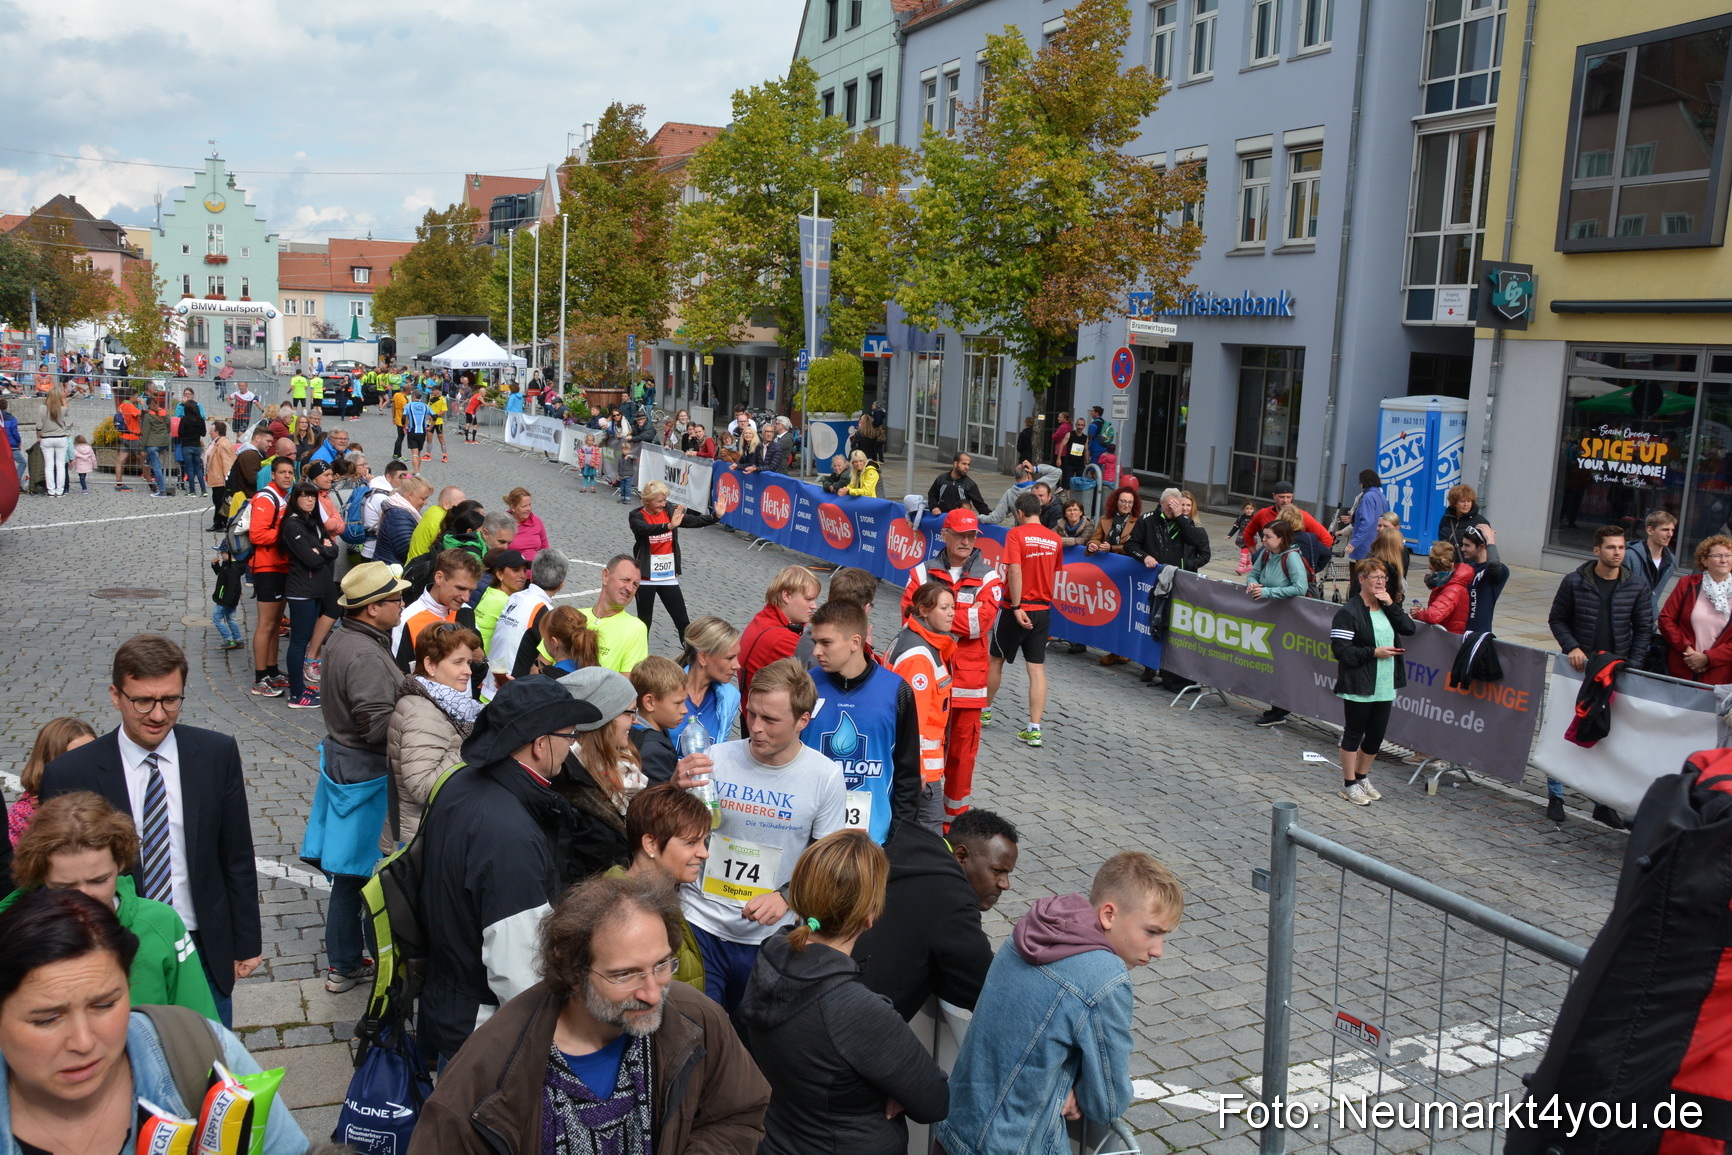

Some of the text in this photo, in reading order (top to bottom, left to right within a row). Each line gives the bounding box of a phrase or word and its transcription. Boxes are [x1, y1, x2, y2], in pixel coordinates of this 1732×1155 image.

[191, 302, 264, 314] BMW Laufsport
[1156, 289, 1295, 317] iffeisenbank
[1131, 321, 1176, 334] Brunnwirtsgasse
[1623, 427, 1651, 442] Opening
[1581, 437, 1669, 464] SPICE UP
[1577, 458, 1667, 479] YOUR WARDROBE!
[762, 491, 790, 521] Hervis
[797, 511, 811, 520] ONLINE
[795, 523, 810, 533] MOBILE
[818, 508, 852, 541] Hervis
[860, 515, 875, 524] STORE
[861, 529, 877, 539] ONLINE
[887, 525, 924, 561] Hervis
[862, 543, 876, 553] MOBILE
[653, 561, 672, 571] 2507
[1053, 571, 1117, 615] Hervis
[1137, 581, 1153, 593] STOR
[1060, 603, 1086, 616] SPORTS
[1135, 621, 1151, 636] MOBIL
[1171, 603, 1270, 655] BOCK
[1198, 641, 1207, 657] by
[1208, 648, 1233, 664] smart
[1234, 655, 1275, 674] concepts
[715, 780, 796, 809] VR BANK
[720, 799, 776, 818] ÜRNBERG
[759, 821, 804, 831] Teilhaberbank
[723, 858, 760, 883] 174
[723, 884, 753, 897] Stephan
[1336, 1017, 1378, 1048] müba
[203, 1093, 232, 1149] HAPPY CAT
[155, 1125, 173, 1150] CAT
